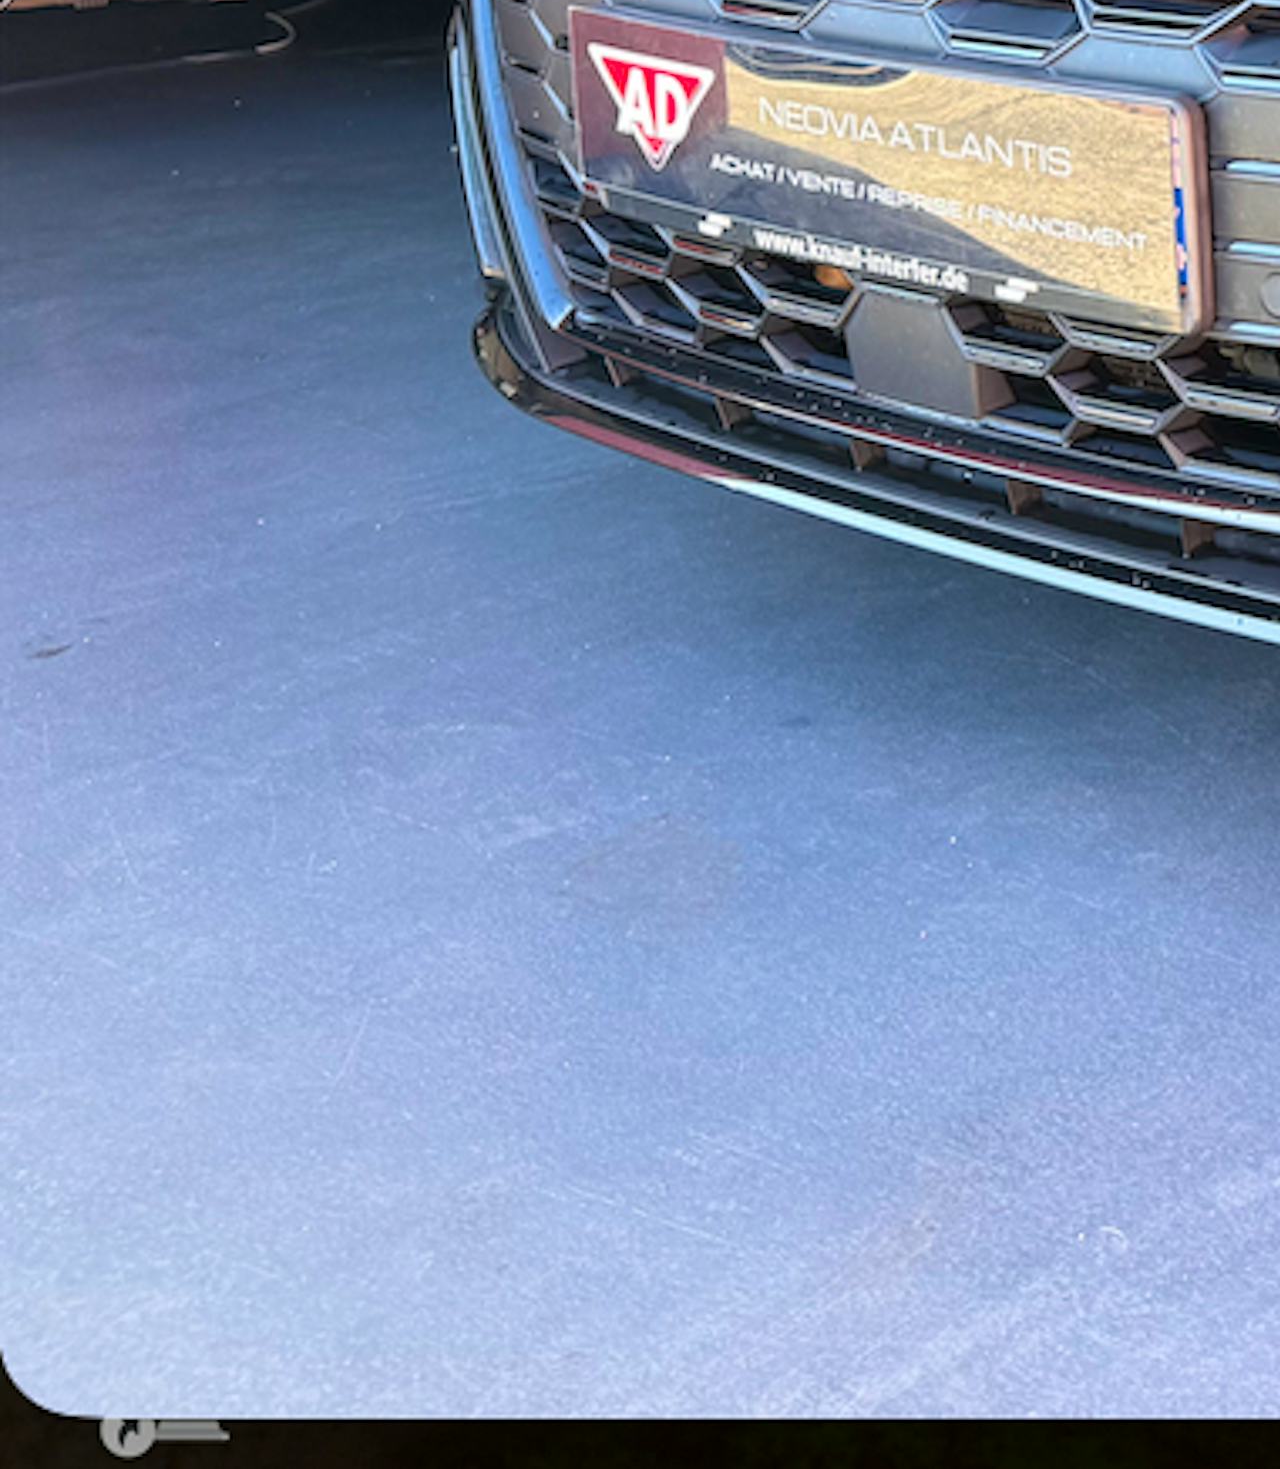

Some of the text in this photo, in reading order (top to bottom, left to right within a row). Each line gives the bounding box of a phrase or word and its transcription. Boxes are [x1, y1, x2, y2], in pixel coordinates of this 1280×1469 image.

[616, 66, 691, 144] AD
[758, 96, 1074, 178] NEOVIA ATLANTIS
[710, 152, 776, 183] ACHAT
[785, 167, 855, 200] VENTE
[867, 184, 963, 221] REPRISE
[977, 205, 1149, 250] FINANCEMENT
[753, 230, 970, 293] www.knauf-interfer.de
